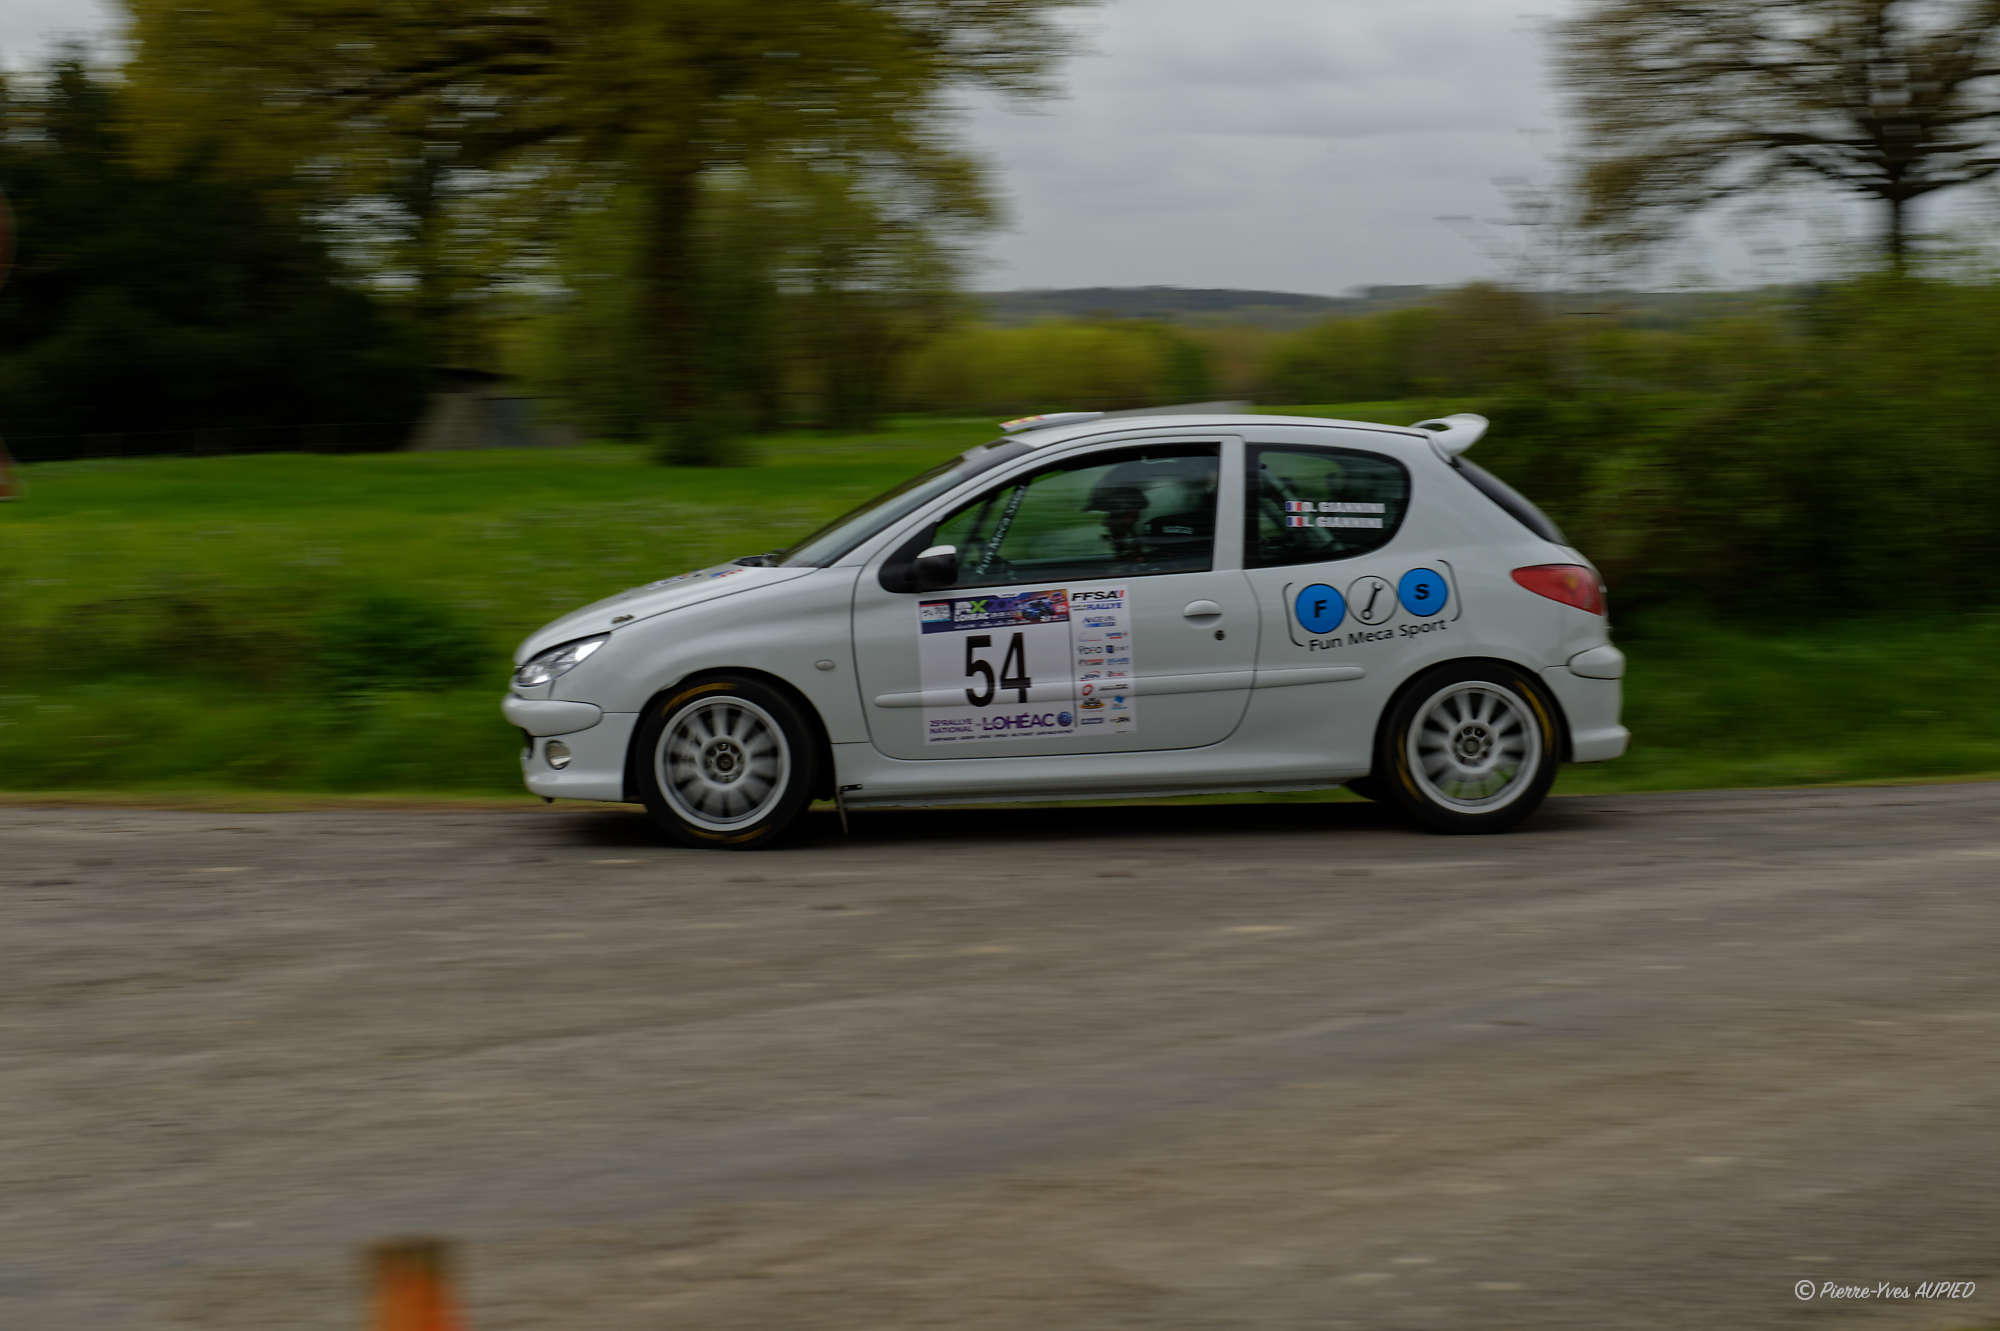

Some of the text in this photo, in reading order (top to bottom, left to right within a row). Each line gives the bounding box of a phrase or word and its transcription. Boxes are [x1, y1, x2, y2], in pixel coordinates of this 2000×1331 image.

[1072, 590, 1117, 601] FFSA
[1314, 583, 1430, 618] F S
[1309, 619, 1447, 651] Fun Meca Sport
[965, 632, 1032, 708] 54
[983, 712, 1055, 731] LOHÉAC
